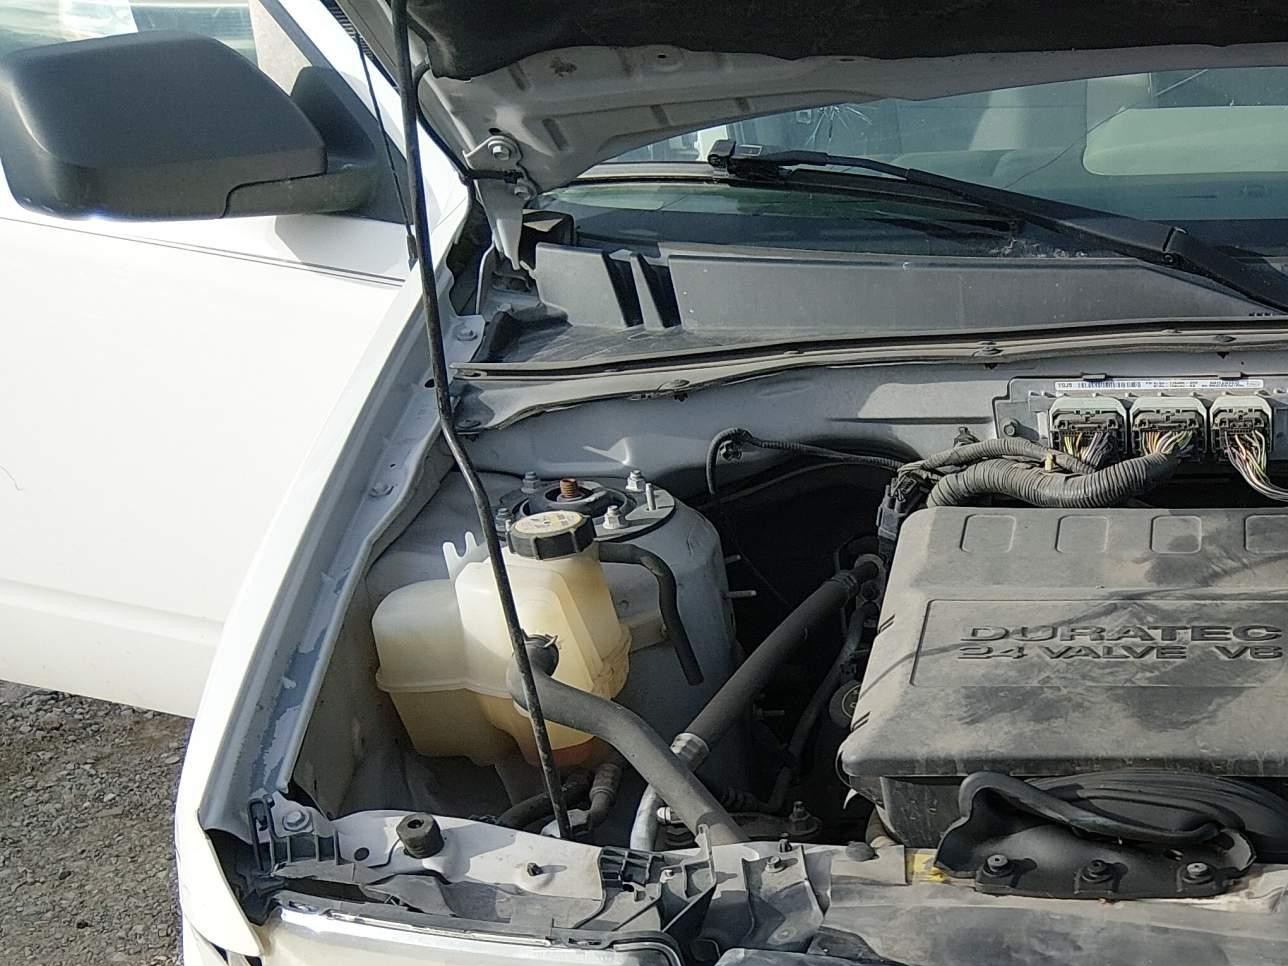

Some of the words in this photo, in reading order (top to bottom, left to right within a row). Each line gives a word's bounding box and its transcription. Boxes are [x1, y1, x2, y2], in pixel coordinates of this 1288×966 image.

[960, 624, 1283, 642] DURATEC
[1040, 644, 1188, 660] VALVE
[1213, 644, 1284, 660] V6
